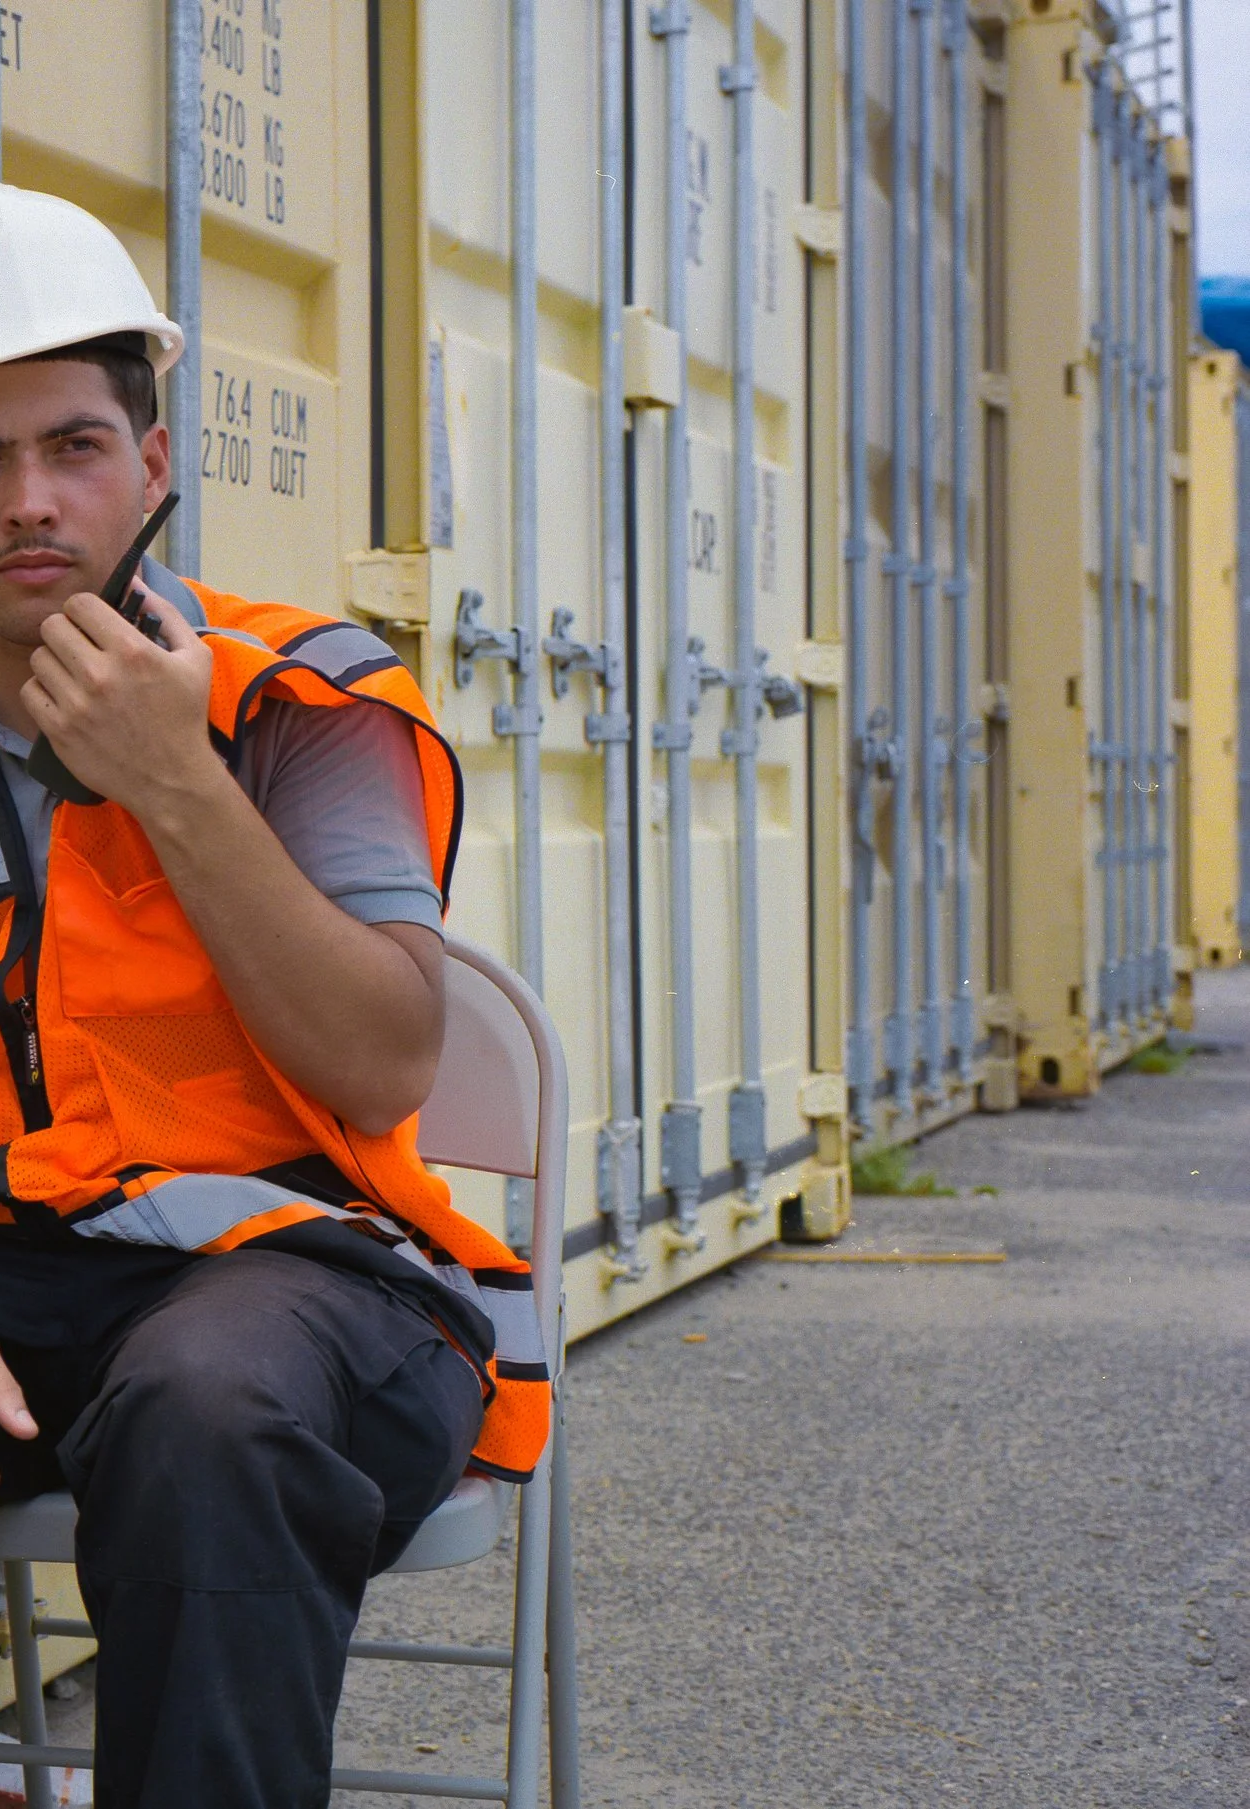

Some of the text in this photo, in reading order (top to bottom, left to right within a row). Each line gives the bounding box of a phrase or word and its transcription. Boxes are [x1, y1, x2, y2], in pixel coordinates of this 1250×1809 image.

[0, 7, 22, 71] ET
[200, 6, 282, 97] .400 LB
[263, 115, 284, 168] KG
[265, 170, 286, 225] LB
[214, 370, 251, 429] 76.4
